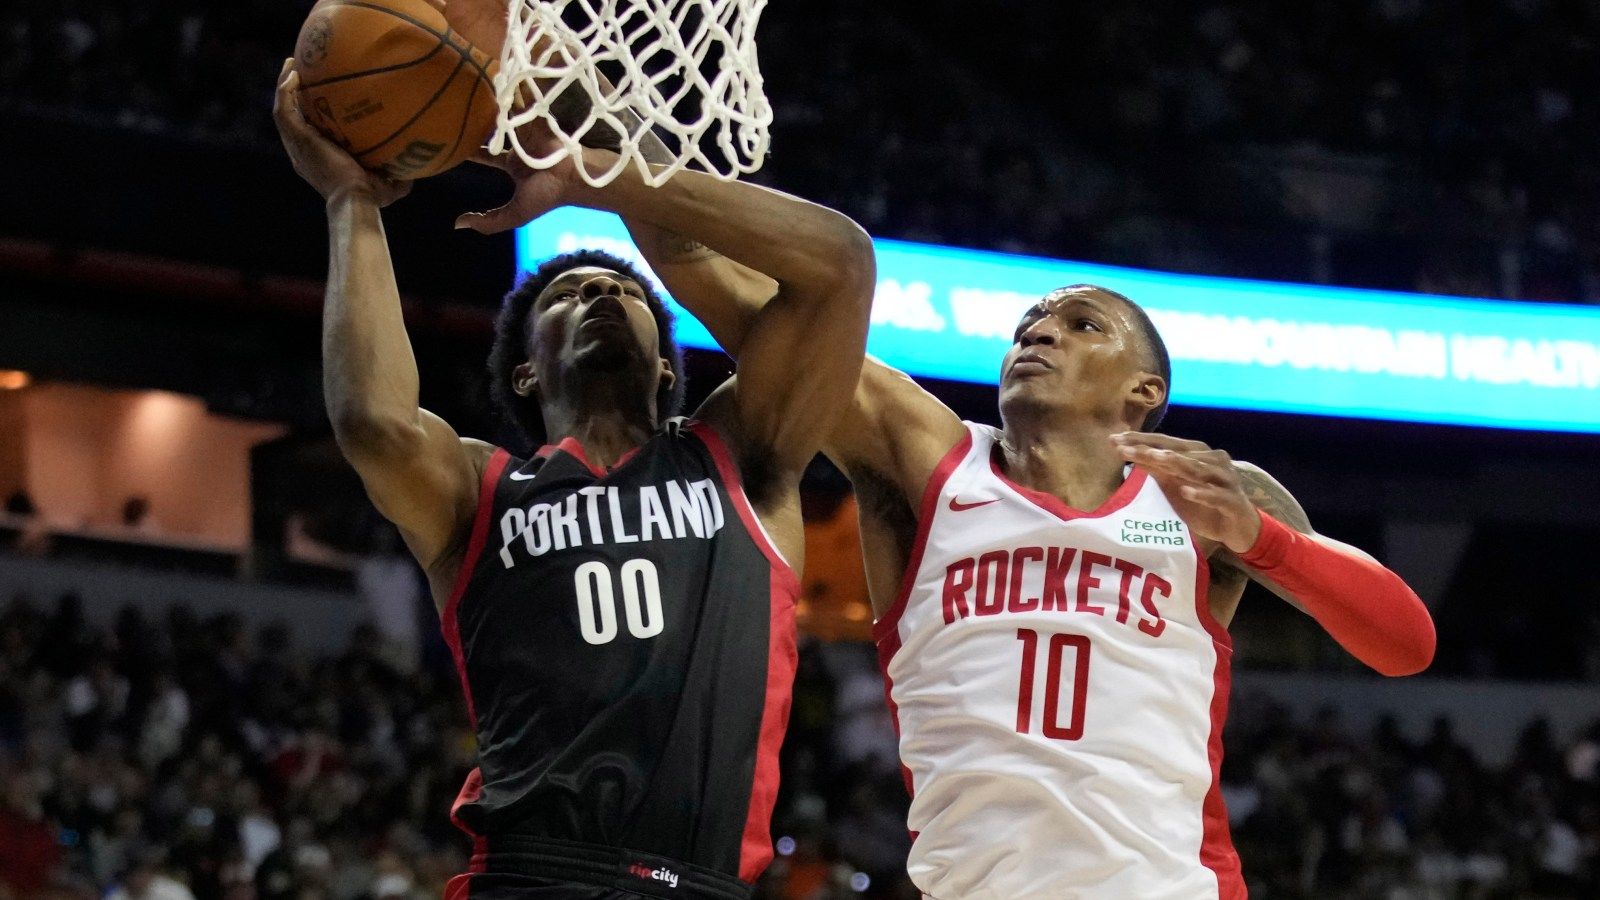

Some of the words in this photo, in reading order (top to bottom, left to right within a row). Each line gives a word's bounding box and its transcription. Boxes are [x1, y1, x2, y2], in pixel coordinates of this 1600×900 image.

[499, 477, 725, 570] PORTLAND
[1121, 528, 1185, 546] karma
[1123, 518, 1183, 533] credit
[574, 558, 665, 645] 00
[941, 546, 1173, 638] ROCKETS
[1015, 628, 1092, 741] 10
